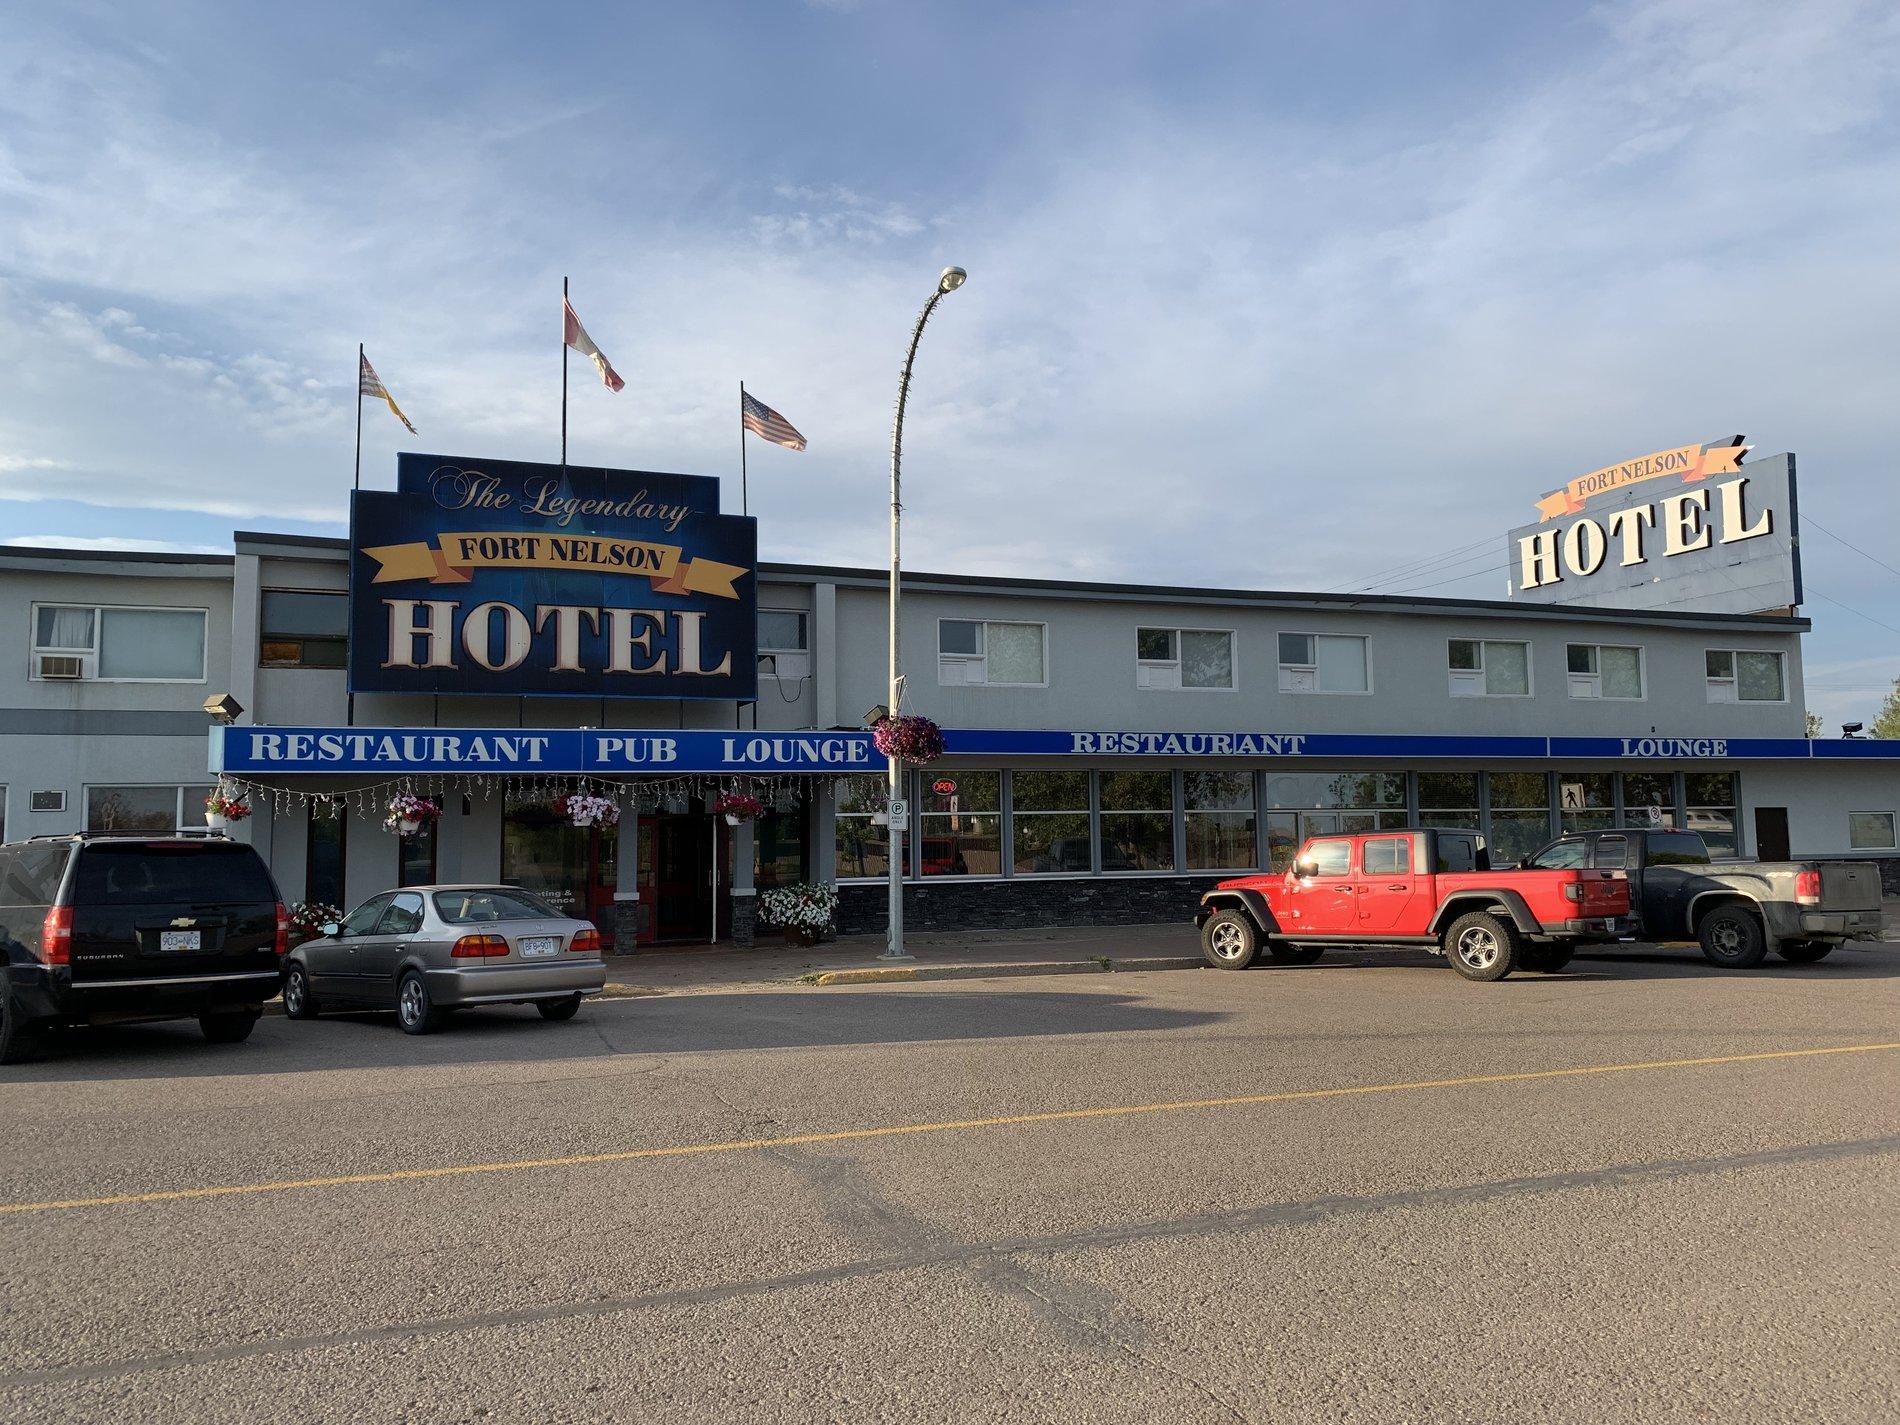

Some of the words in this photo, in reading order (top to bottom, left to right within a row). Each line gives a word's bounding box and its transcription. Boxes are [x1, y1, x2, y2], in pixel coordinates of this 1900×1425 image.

[1577, 468, 1617, 496] FORT
[1621, 450, 1690, 482] NELSON
[428, 465, 511, 510] The
[520, 475, 700, 532] Legendary
[1517, 477, 1773, 590] HOTEL
[458, 537, 540, 561] FORT
[549, 538, 666, 570] NELSON
[380, 598, 733, 678] HOTEL
[249, 733, 549, 762] RESTAURANT
[596, 737, 677, 762] PUB
[722, 738, 869, 763] LOUNGE
[1070, 732, 1306, 755] RESTAURANT
[1620, 738, 1728, 757] LOUNGE
[935, 782, 955, 792] OPEN
